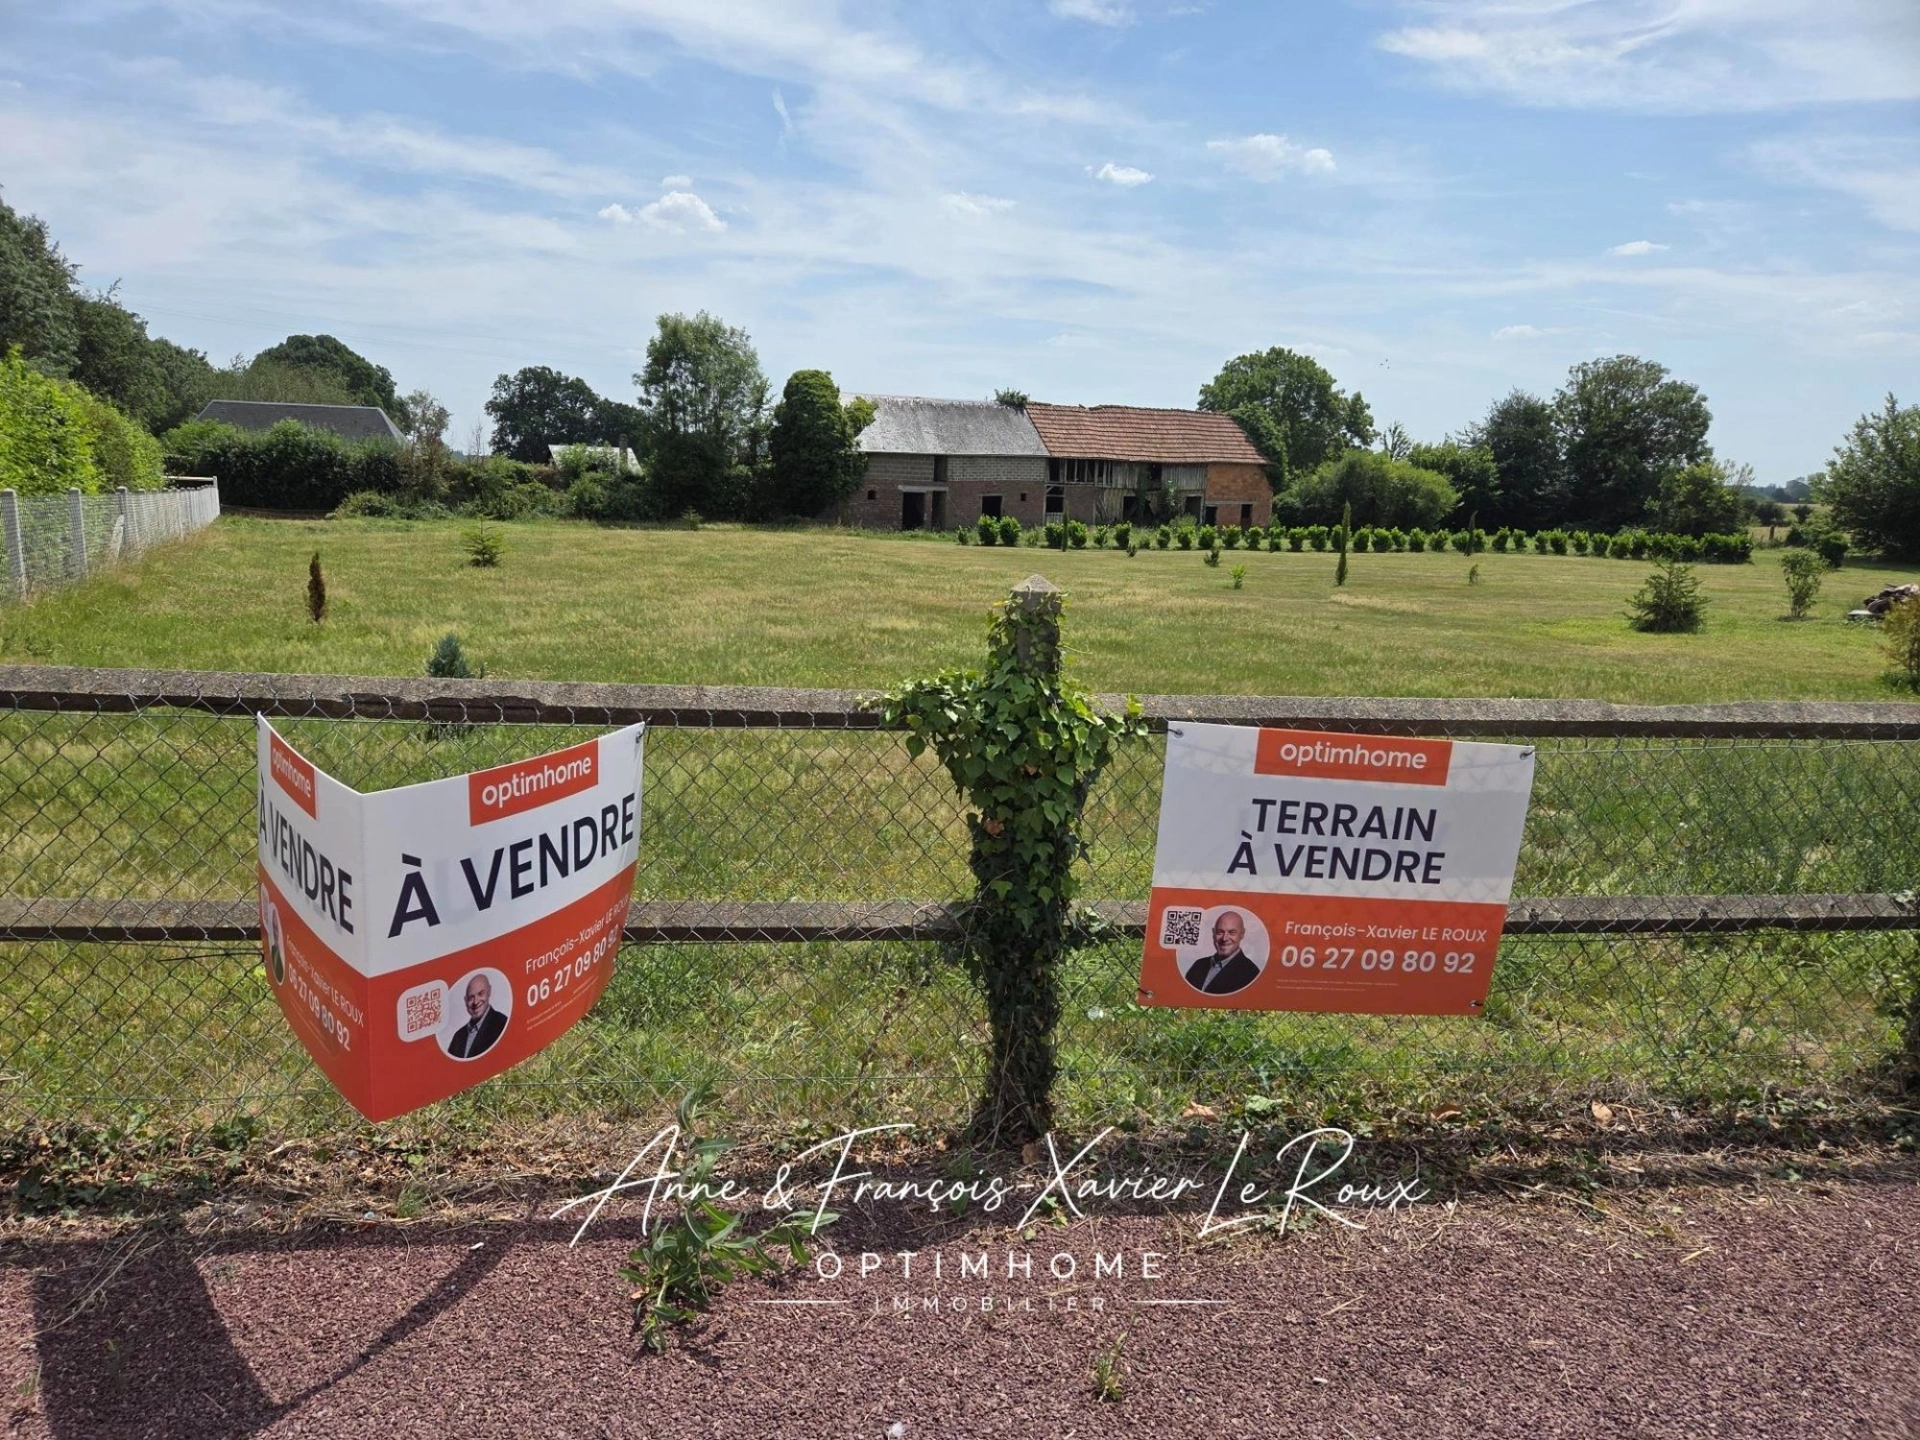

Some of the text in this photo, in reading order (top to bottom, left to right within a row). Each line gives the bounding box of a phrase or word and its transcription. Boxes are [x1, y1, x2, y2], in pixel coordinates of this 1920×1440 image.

[481, 755, 592, 808] optimhome
[1280, 742, 1427, 770] optimhome
[1252, 798, 1437, 842] TERRAIN
[259, 770, 267, 844] À
[269, 801, 354, 935] VENDRE
[387, 793, 635, 938] À VENDRE
[1227, 829, 1446, 885] À VENDRE
[526, 917, 604, 974] François-Xavier
[605, 908, 613, 924] LE
[1281, 945, 1475, 973] 06 27 09 80 92
[1285, 921, 1487, 943] François-Xavier LE ROUX
[527, 978, 550, 1007] 06
[554, 964, 572, 992] 27
[575, 951, 591, 978] 09
[593, 937, 607, 963] 80
[288, 963, 351, 1051] 06 27 09 80 92
[331, 987, 339, 1006] LE
[340, 994, 364, 1028] ROUX
